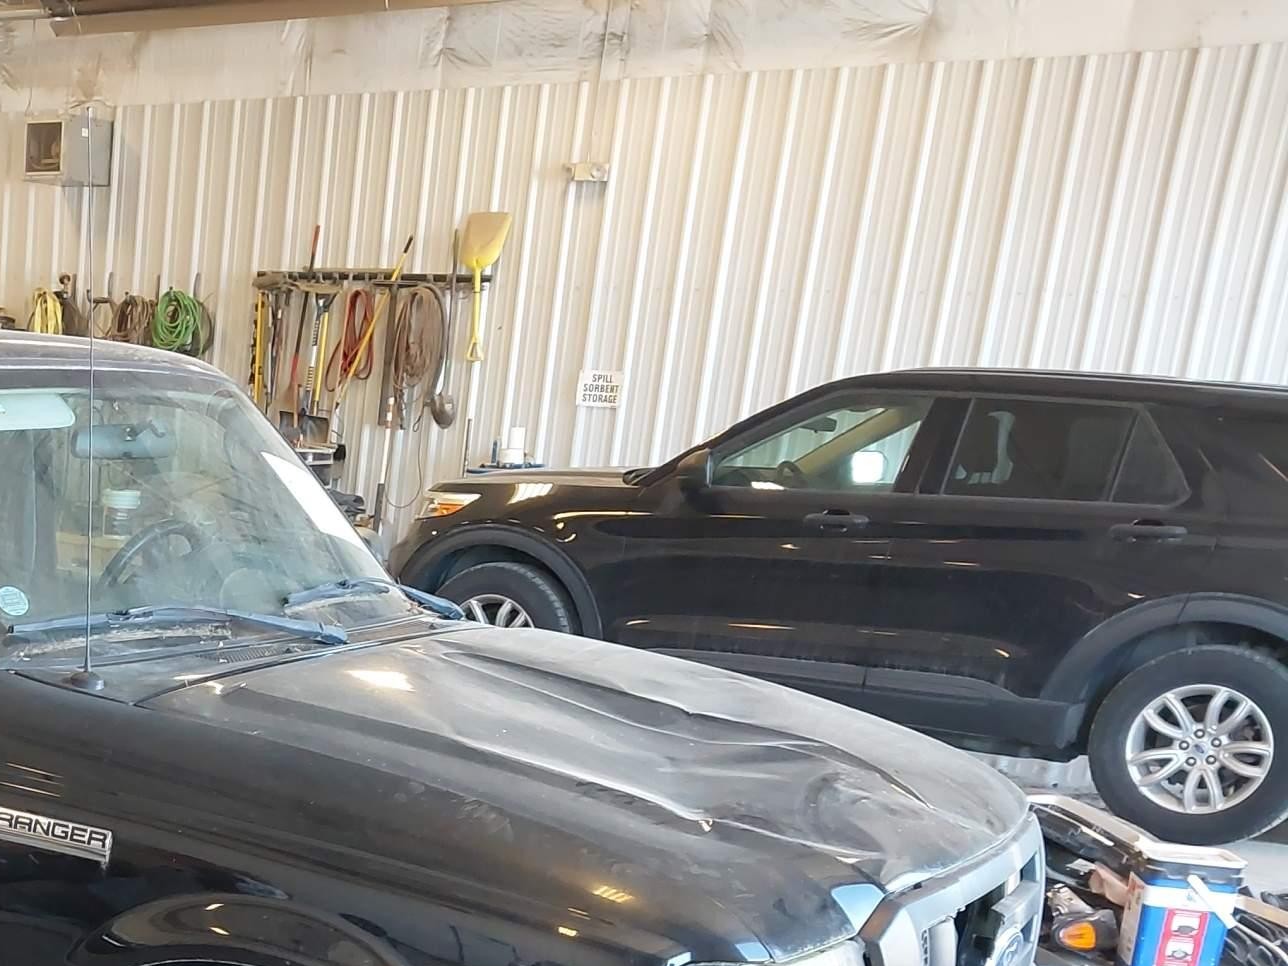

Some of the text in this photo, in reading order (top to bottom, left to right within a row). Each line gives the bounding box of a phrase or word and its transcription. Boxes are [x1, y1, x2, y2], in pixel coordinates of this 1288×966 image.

[592, 374, 613, 384] SPILL
[583, 383, 619, 394] SORBENT
[582, 393, 618, 404] STORAGE
